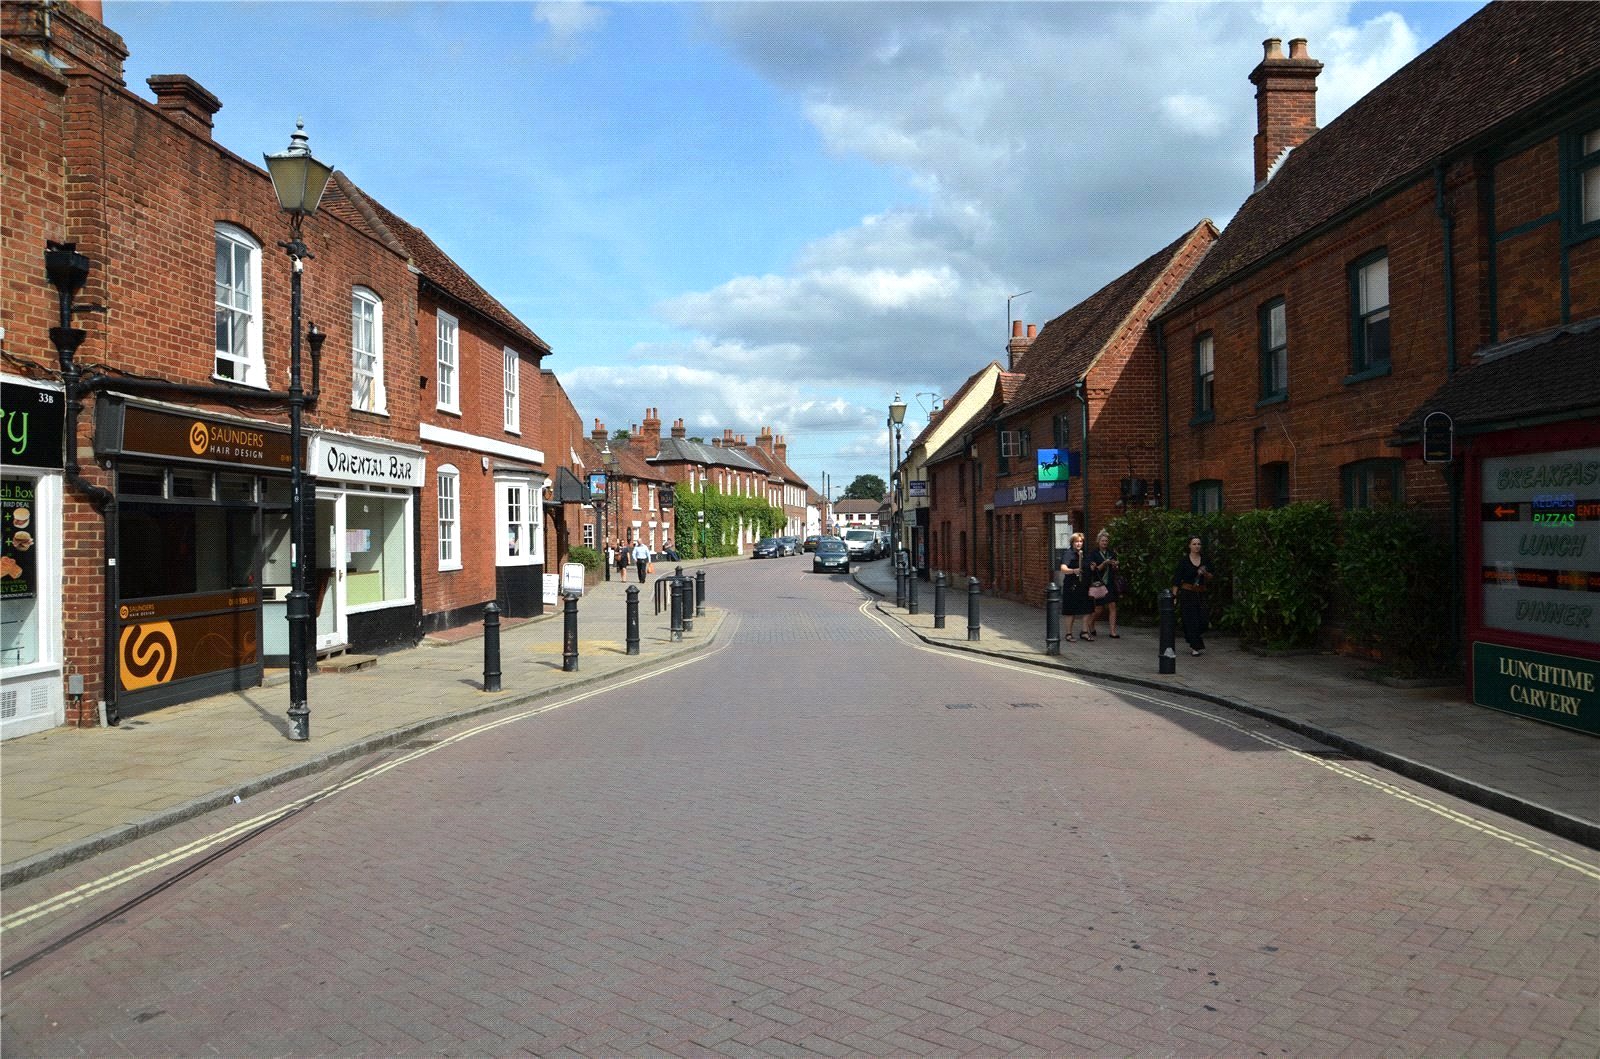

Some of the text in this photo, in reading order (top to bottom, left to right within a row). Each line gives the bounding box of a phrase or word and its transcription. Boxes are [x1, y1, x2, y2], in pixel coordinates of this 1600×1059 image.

[38, 392, 54, 404] 33B
[0, 410, 29, 455] y
[210, 426, 264, 448] SAUNDERS
[209, 445, 264, 459] HAIR DESIGN
[327, 446, 412, 480] ORIENTAL BAR
[1497, 460, 1600, 490] BREAKFAS
[15, 485, 34, 499] Box
[1533, 513, 1576, 527] PIZZAS
[1519, 534, 1586, 557] LUNCH
[1516, 600, 1592, 628] DINNER
[1499, 656, 1595, 693] LUNCHTIME
[1510, 684, 1581, 717] CARVERY
